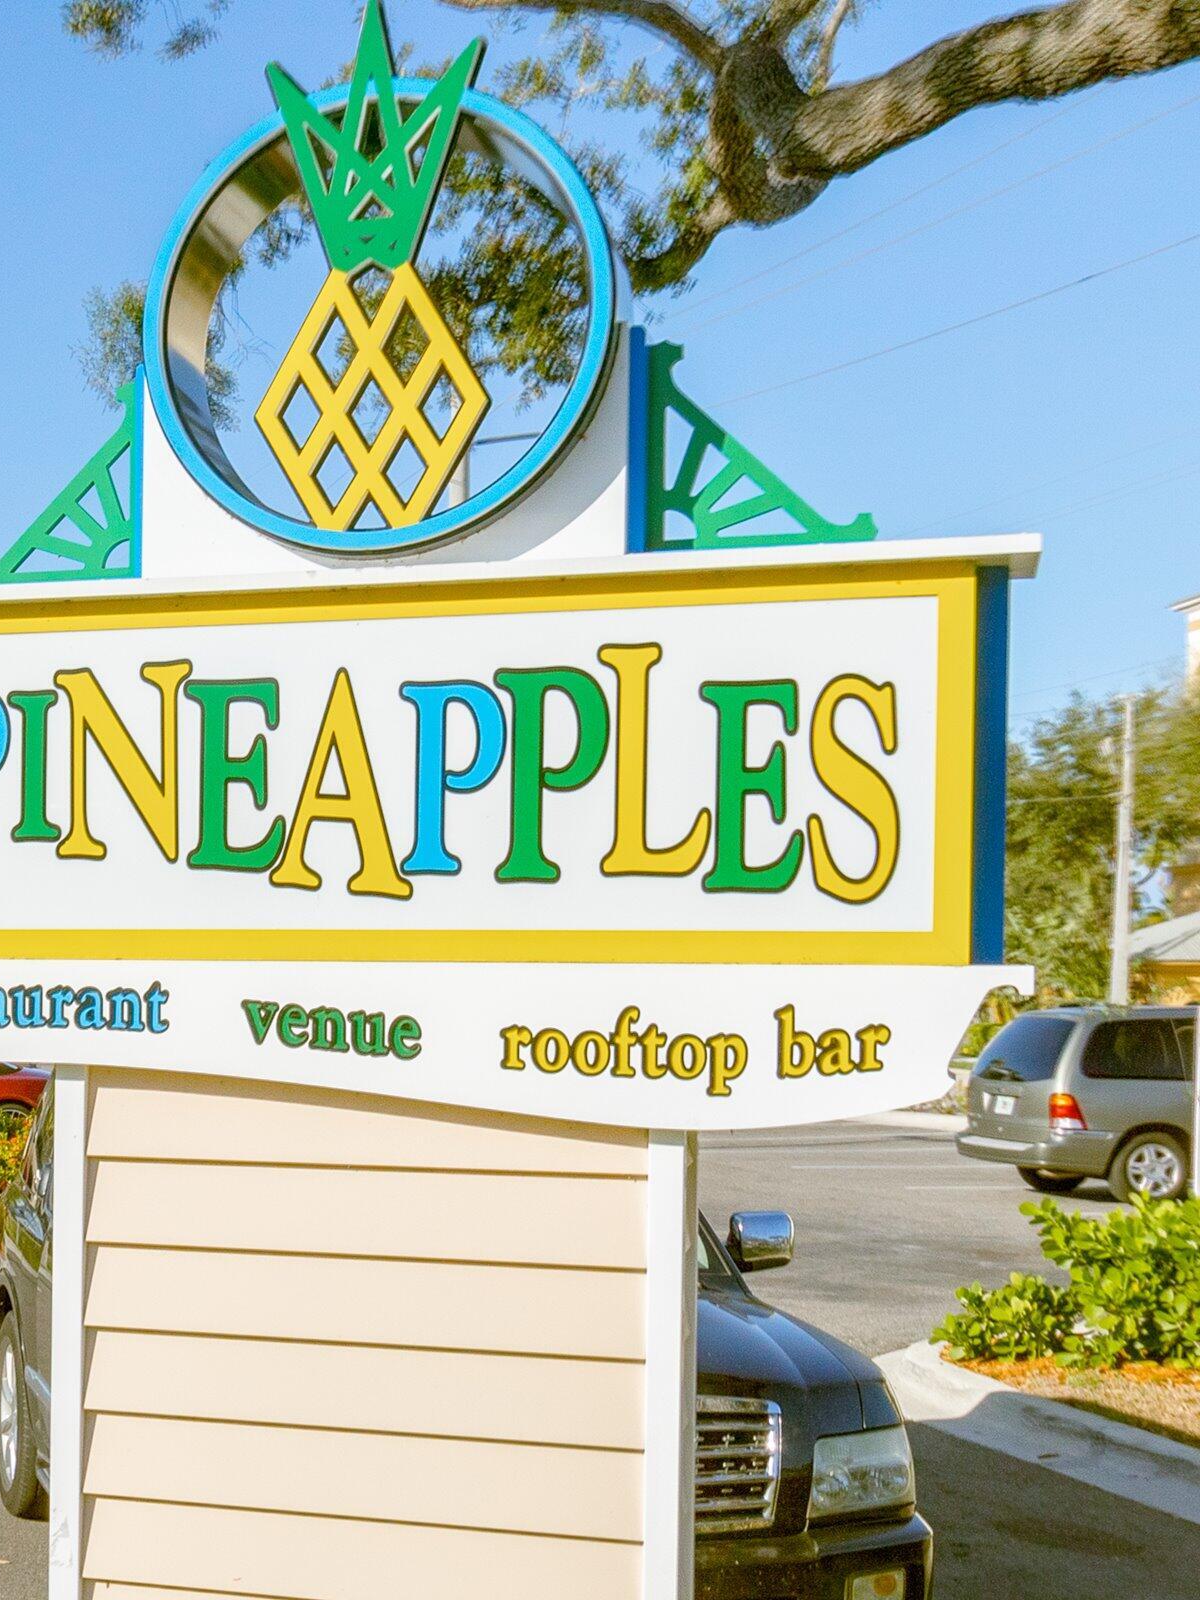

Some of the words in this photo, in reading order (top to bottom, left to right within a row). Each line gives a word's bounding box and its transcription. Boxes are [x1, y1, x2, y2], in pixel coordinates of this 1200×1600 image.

[241, 1000, 421, 1060] venue
[500, 1005, 748, 1097] rooftop
[774, 1004, 891, 1080] bar
